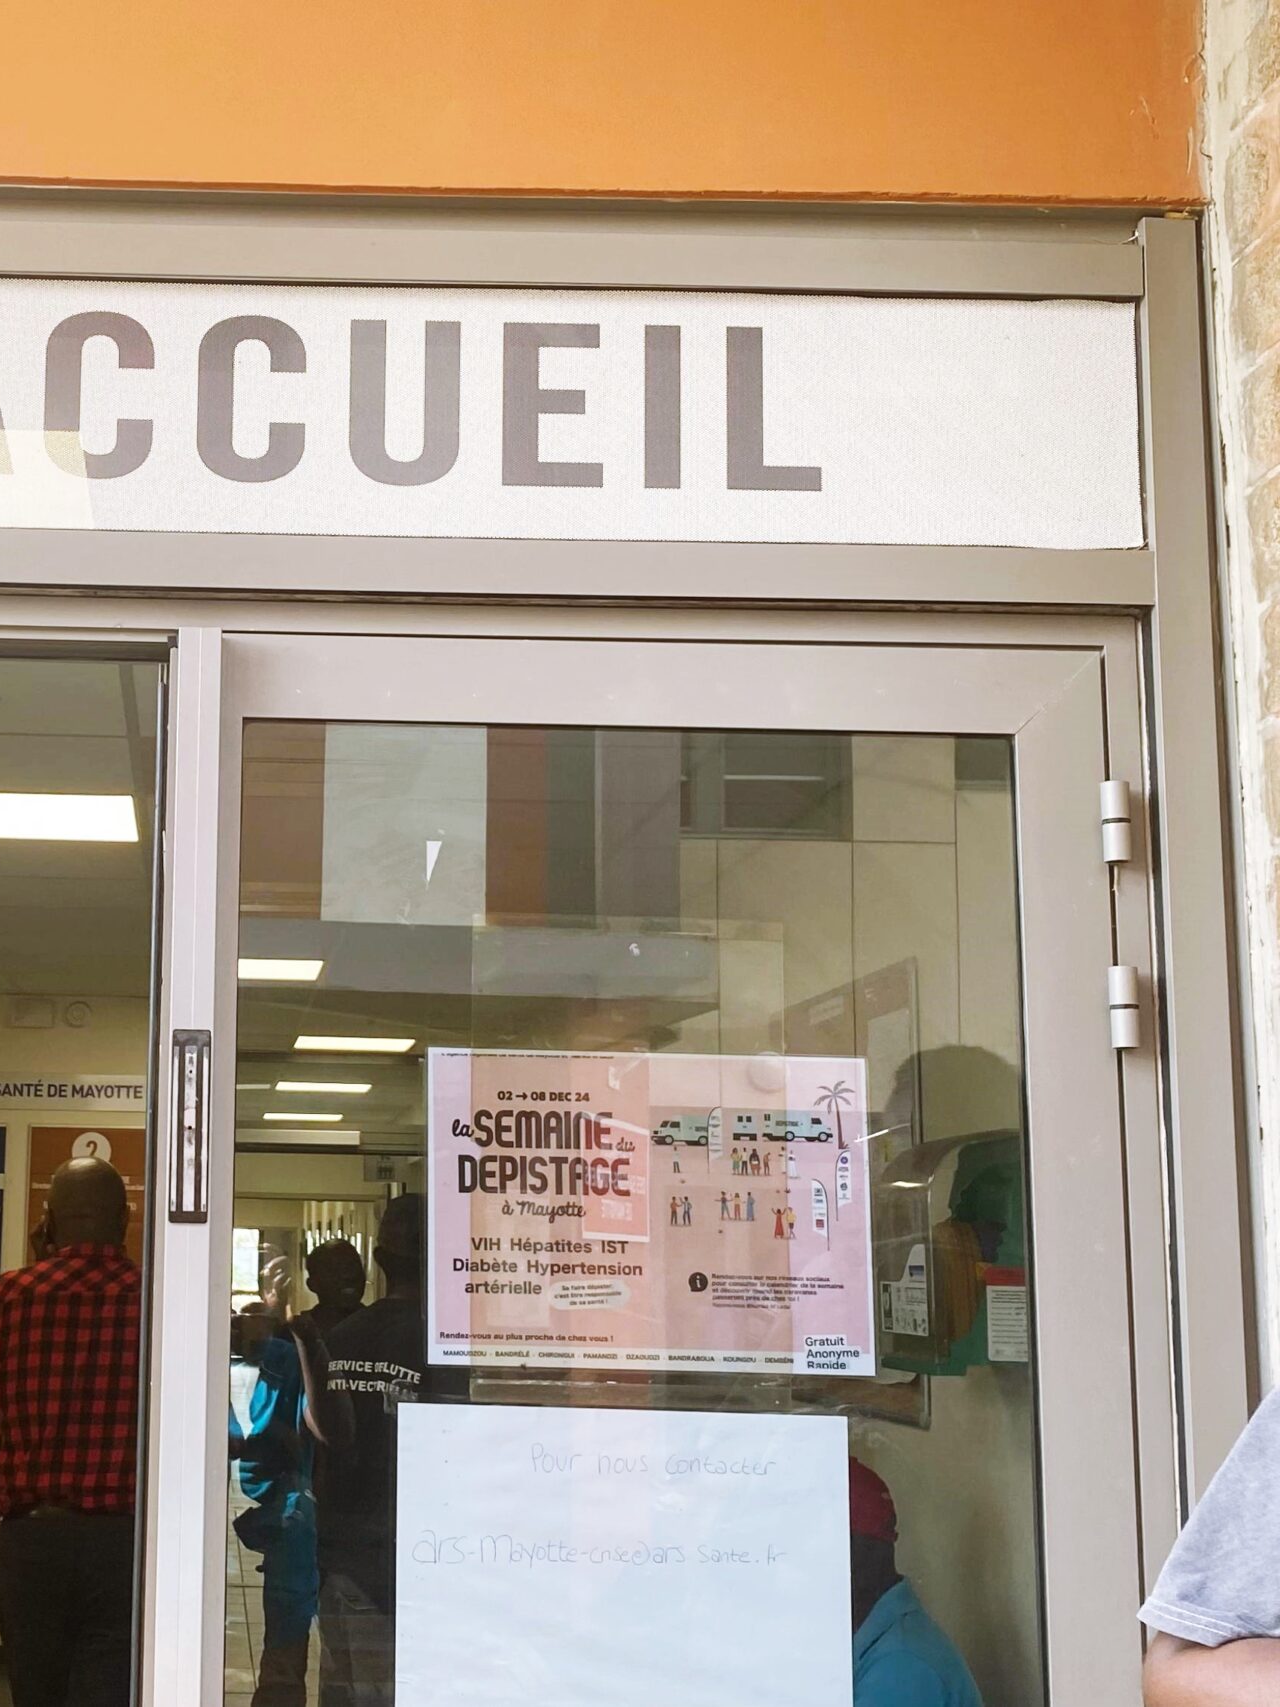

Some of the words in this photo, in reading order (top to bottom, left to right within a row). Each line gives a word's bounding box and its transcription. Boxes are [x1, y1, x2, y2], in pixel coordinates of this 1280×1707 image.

[47, 1083, 68, 1098] DE
[71, 1084, 144, 1099] MAYOTTE
[497, 1091, 513, 1101] 02
[530, 1091, 546, 1101] 08
[549, 1092, 572, 1102] DEC
[574, 1092, 590, 1102] 24
[452, 1118, 474, 1138] la
[473, 1109, 613, 1151] SEMAINE
[615, 1137, 636, 1152] du
[458, 1154, 631, 1197] DEPISTAGE
[501, 1200, 514, 1216] à
[516, 1200, 586, 1223] Mayotte
[471, 1237, 501, 1251] VIH
[510, 1237, 593, 1254] Hépatites
[601, 1240, 629, 1254] IST
[452, 1257, 518, 1273] Diabète
[527, 1259, 643, 1277] Hypertension
[464, 1280, 543, 1295] artérielle
[439, 1331, 492, 1340] Rendez-vous
[505, 1332, 523, 1342] plus
[524, 1333, 554, 1342] proche
[555, 1333, 566, 1341] de
[805, 1336, 845, 1347] Gratuit
[806, 1348, 860, 1360] Anonyme
[328, 1360, 373, 1372] SERVICE
[531, 1441, 583, 1474] Pour
[597, 1454, 649, 1476] nous
